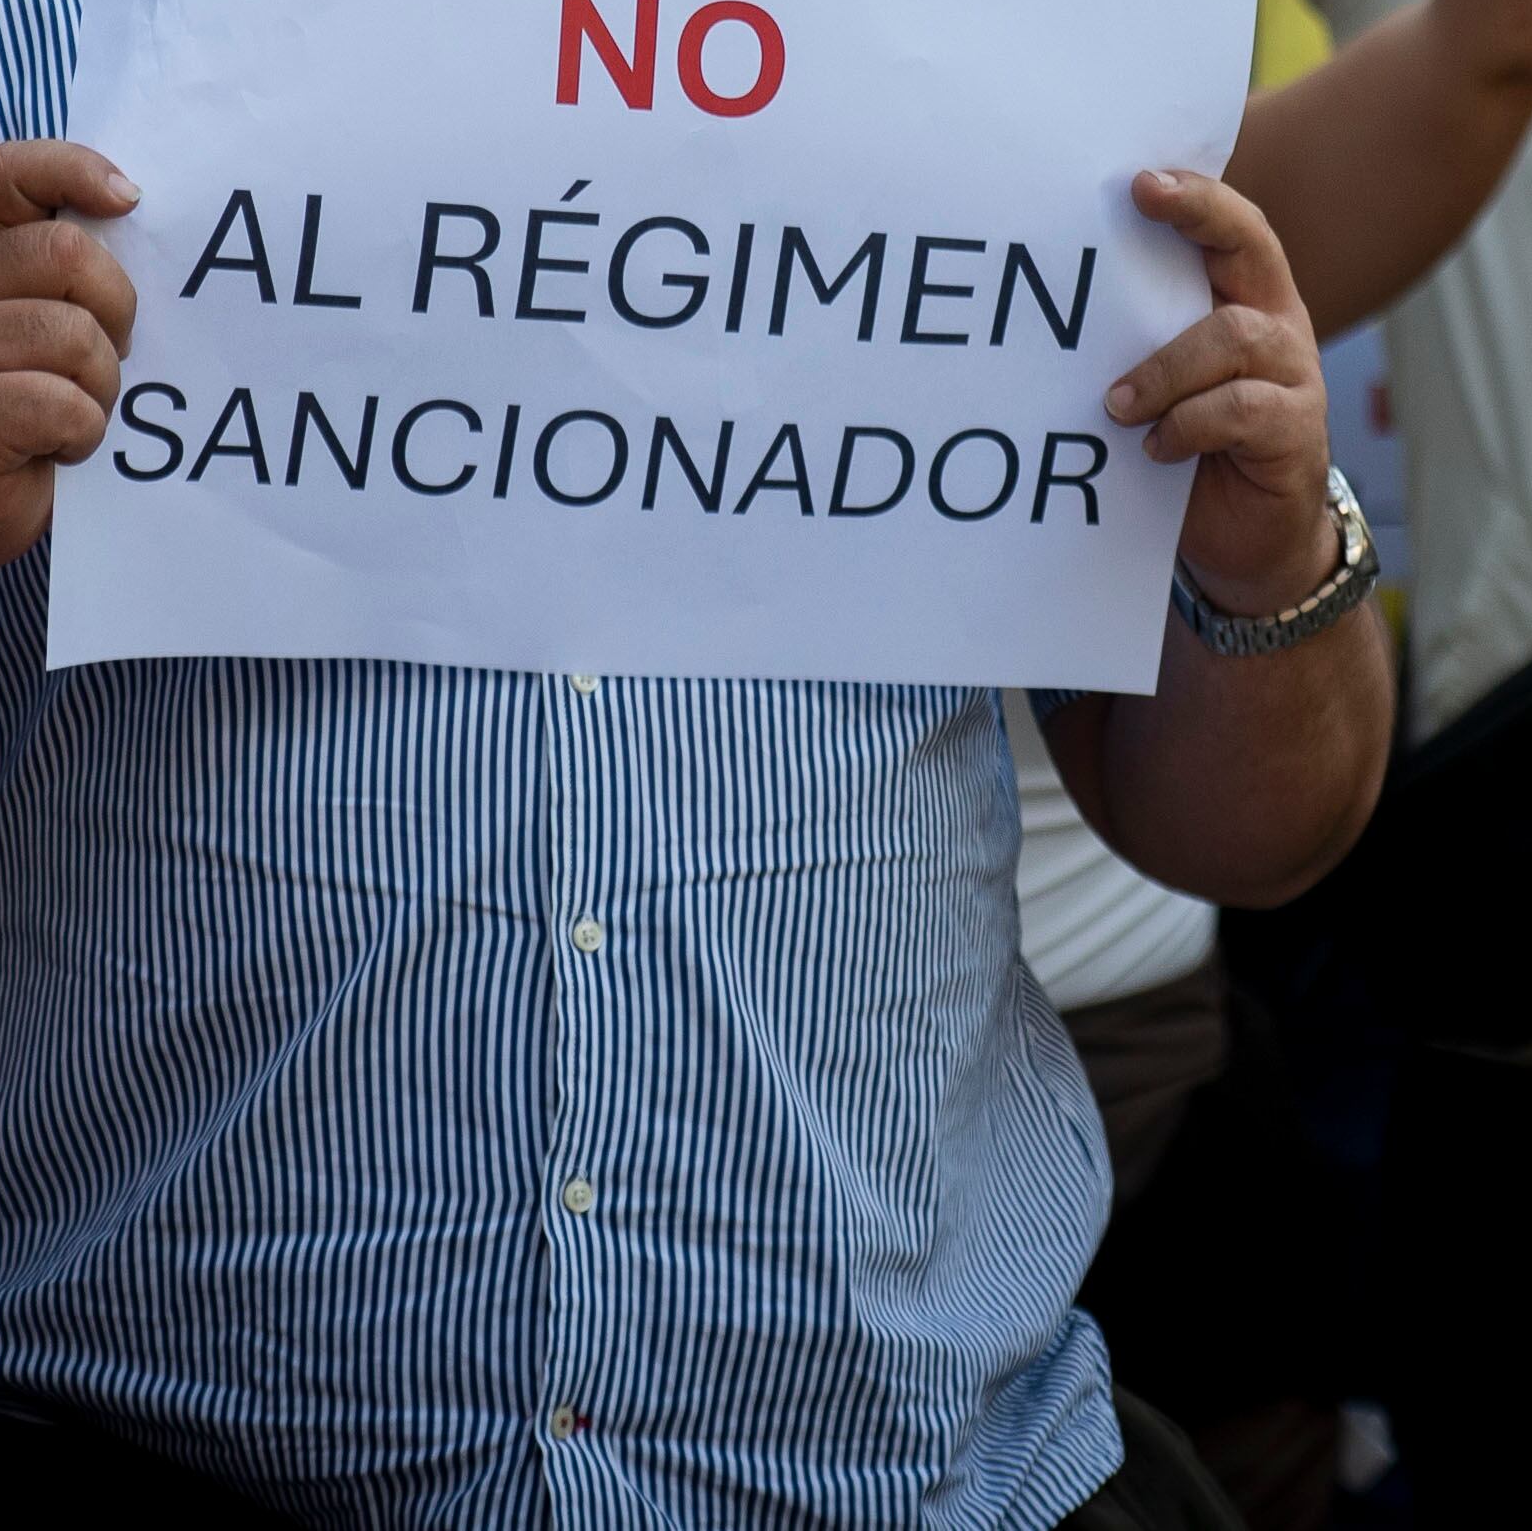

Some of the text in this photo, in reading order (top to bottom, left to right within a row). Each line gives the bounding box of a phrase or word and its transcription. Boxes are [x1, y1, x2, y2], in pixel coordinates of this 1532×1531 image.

[182, 179, 1097, 351] AL RÉGIMEN
[111, 380, 1110, 527] SANCIONADOR
